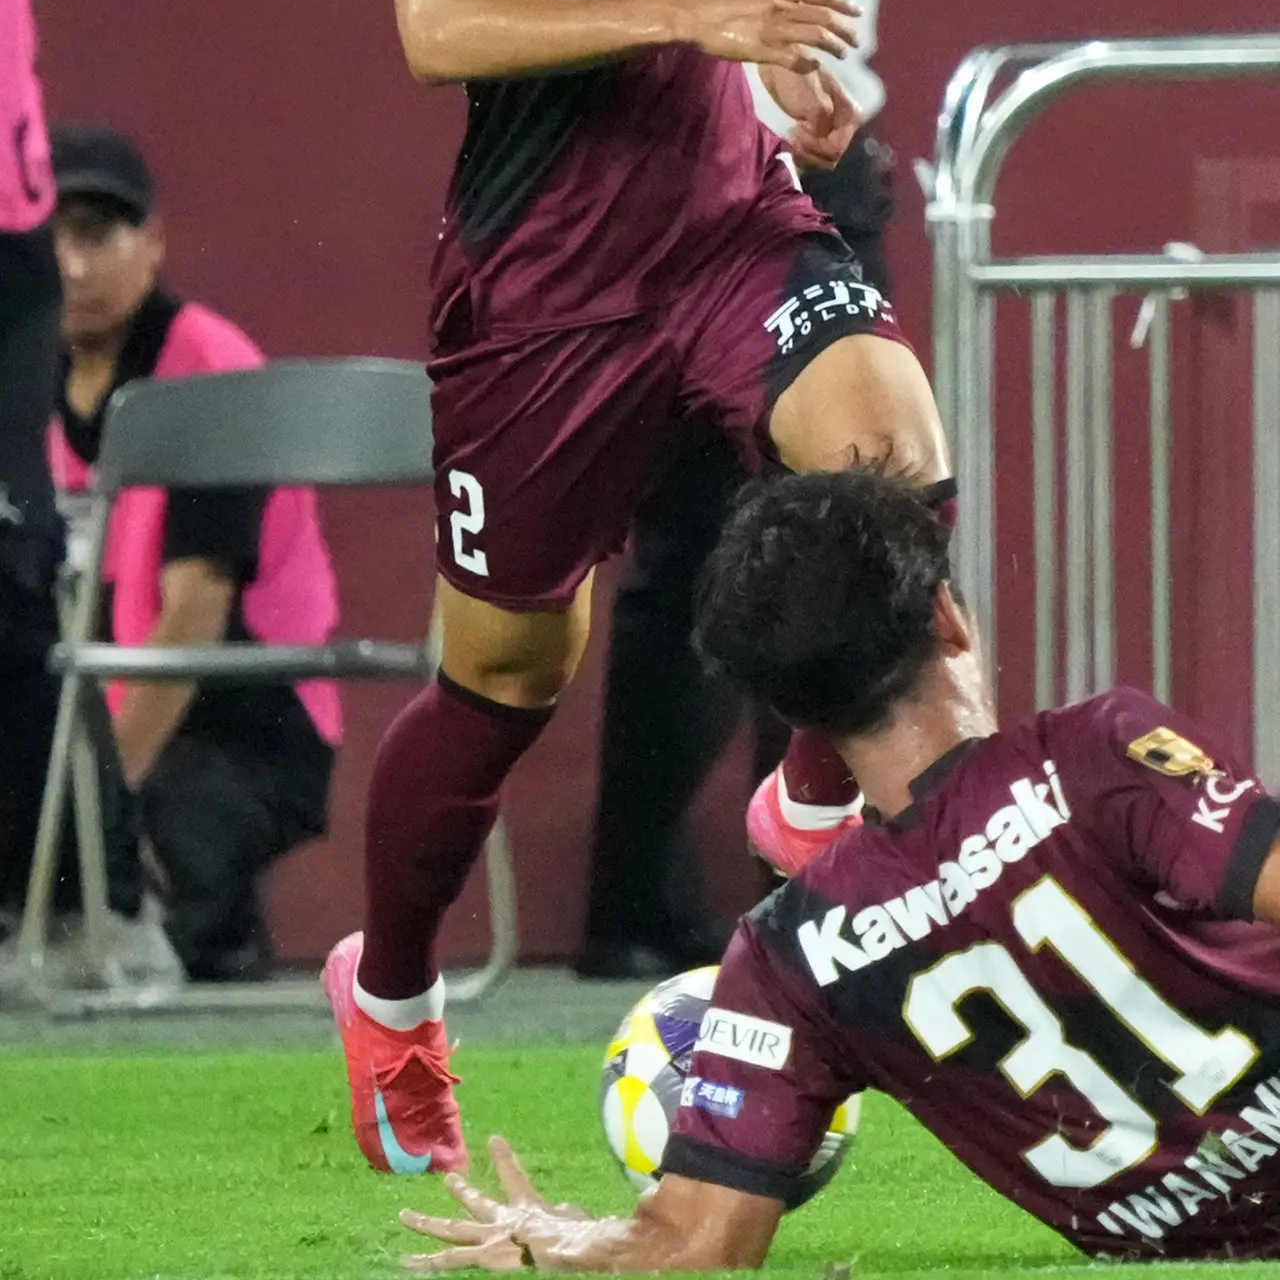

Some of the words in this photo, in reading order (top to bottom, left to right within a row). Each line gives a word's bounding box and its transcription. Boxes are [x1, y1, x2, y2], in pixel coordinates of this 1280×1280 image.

[448, 468, 489, 577] 2
[797, 759, 1073, 987] Kawasaki
[902, 874, 1260, 1188] 31
